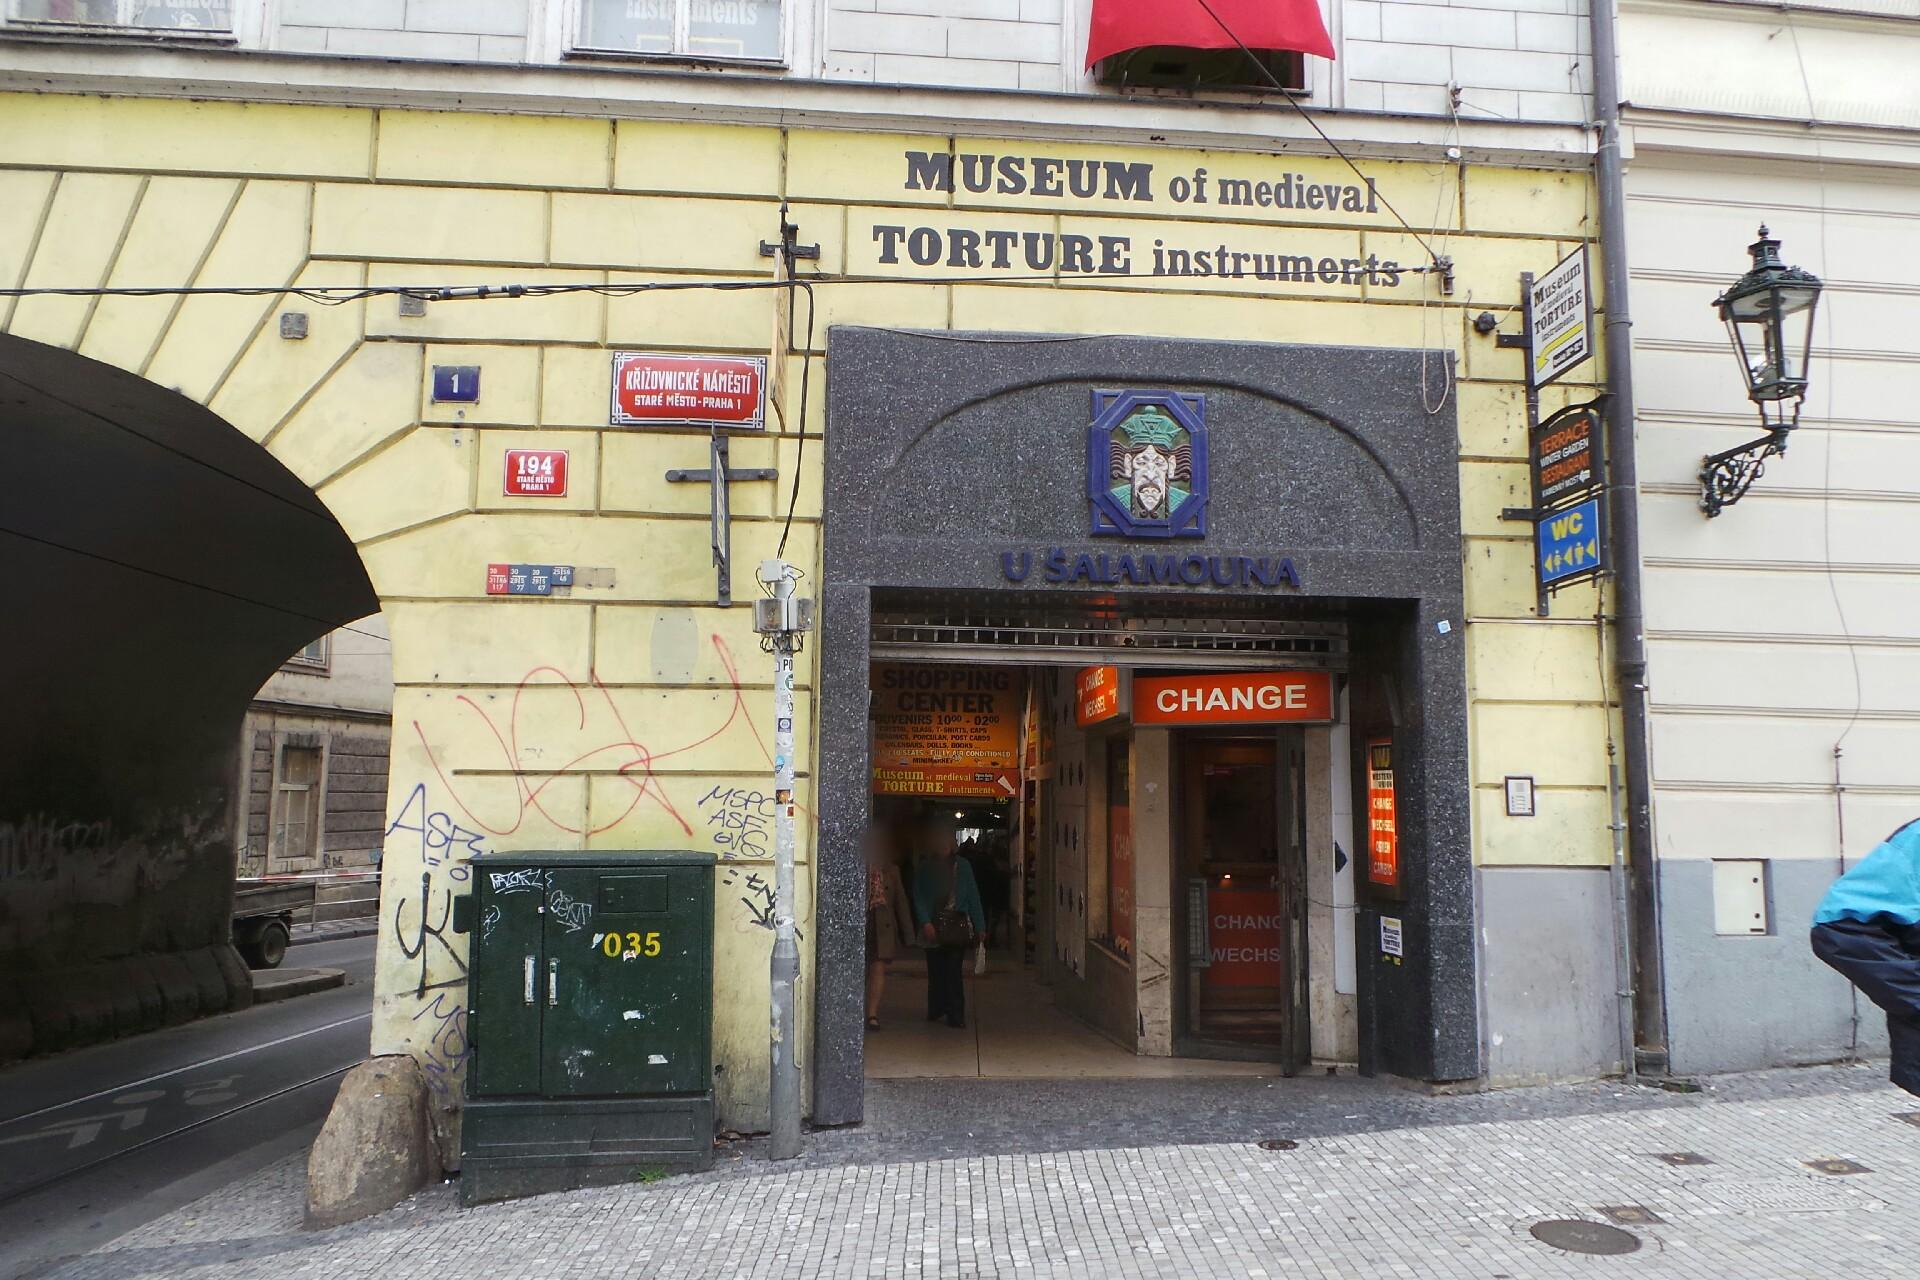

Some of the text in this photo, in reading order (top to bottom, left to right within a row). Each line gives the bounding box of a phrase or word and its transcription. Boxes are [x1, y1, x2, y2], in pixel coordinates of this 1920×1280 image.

[905, 151, 1378, 214] MUSEUM of medieval
[873, 225, 1400, 287] TORTURE instruments
[1534, 263, 1581, 308] Museum
[1534, 289, 1582, 334] TORTURE
[451, 373, 459, 394] 1
[625, 366, 752, 395] KŘIŽOVNICKÉ NÁMĚSTÍ
[634, 392, 663, 406] STARÉ
[702, 397, 734, 410] PRAHA
[736, 399, 741, 410] 1
[1540, 418, 1590, 455] TERRACE
[517, 455, 553, 475] 194
[520, 483, 544, 491] PRAHA
[1551, 512, 1584, 541] WC
[1003, 551, 1032, 582] U
[881, 668, 1010, 690] SHOPPING
[1085, 667, 1105, 691] CHANGE
[896, 690, 994, 713] CENTER
[1156, 684, 1308, 713] CHANGE
[873, 768, 924, 780] Museum
[935, 773, 972, 782] medieval
[882, 781, 944, 793] TORTURE
[603, 932, 662, 958] 035
